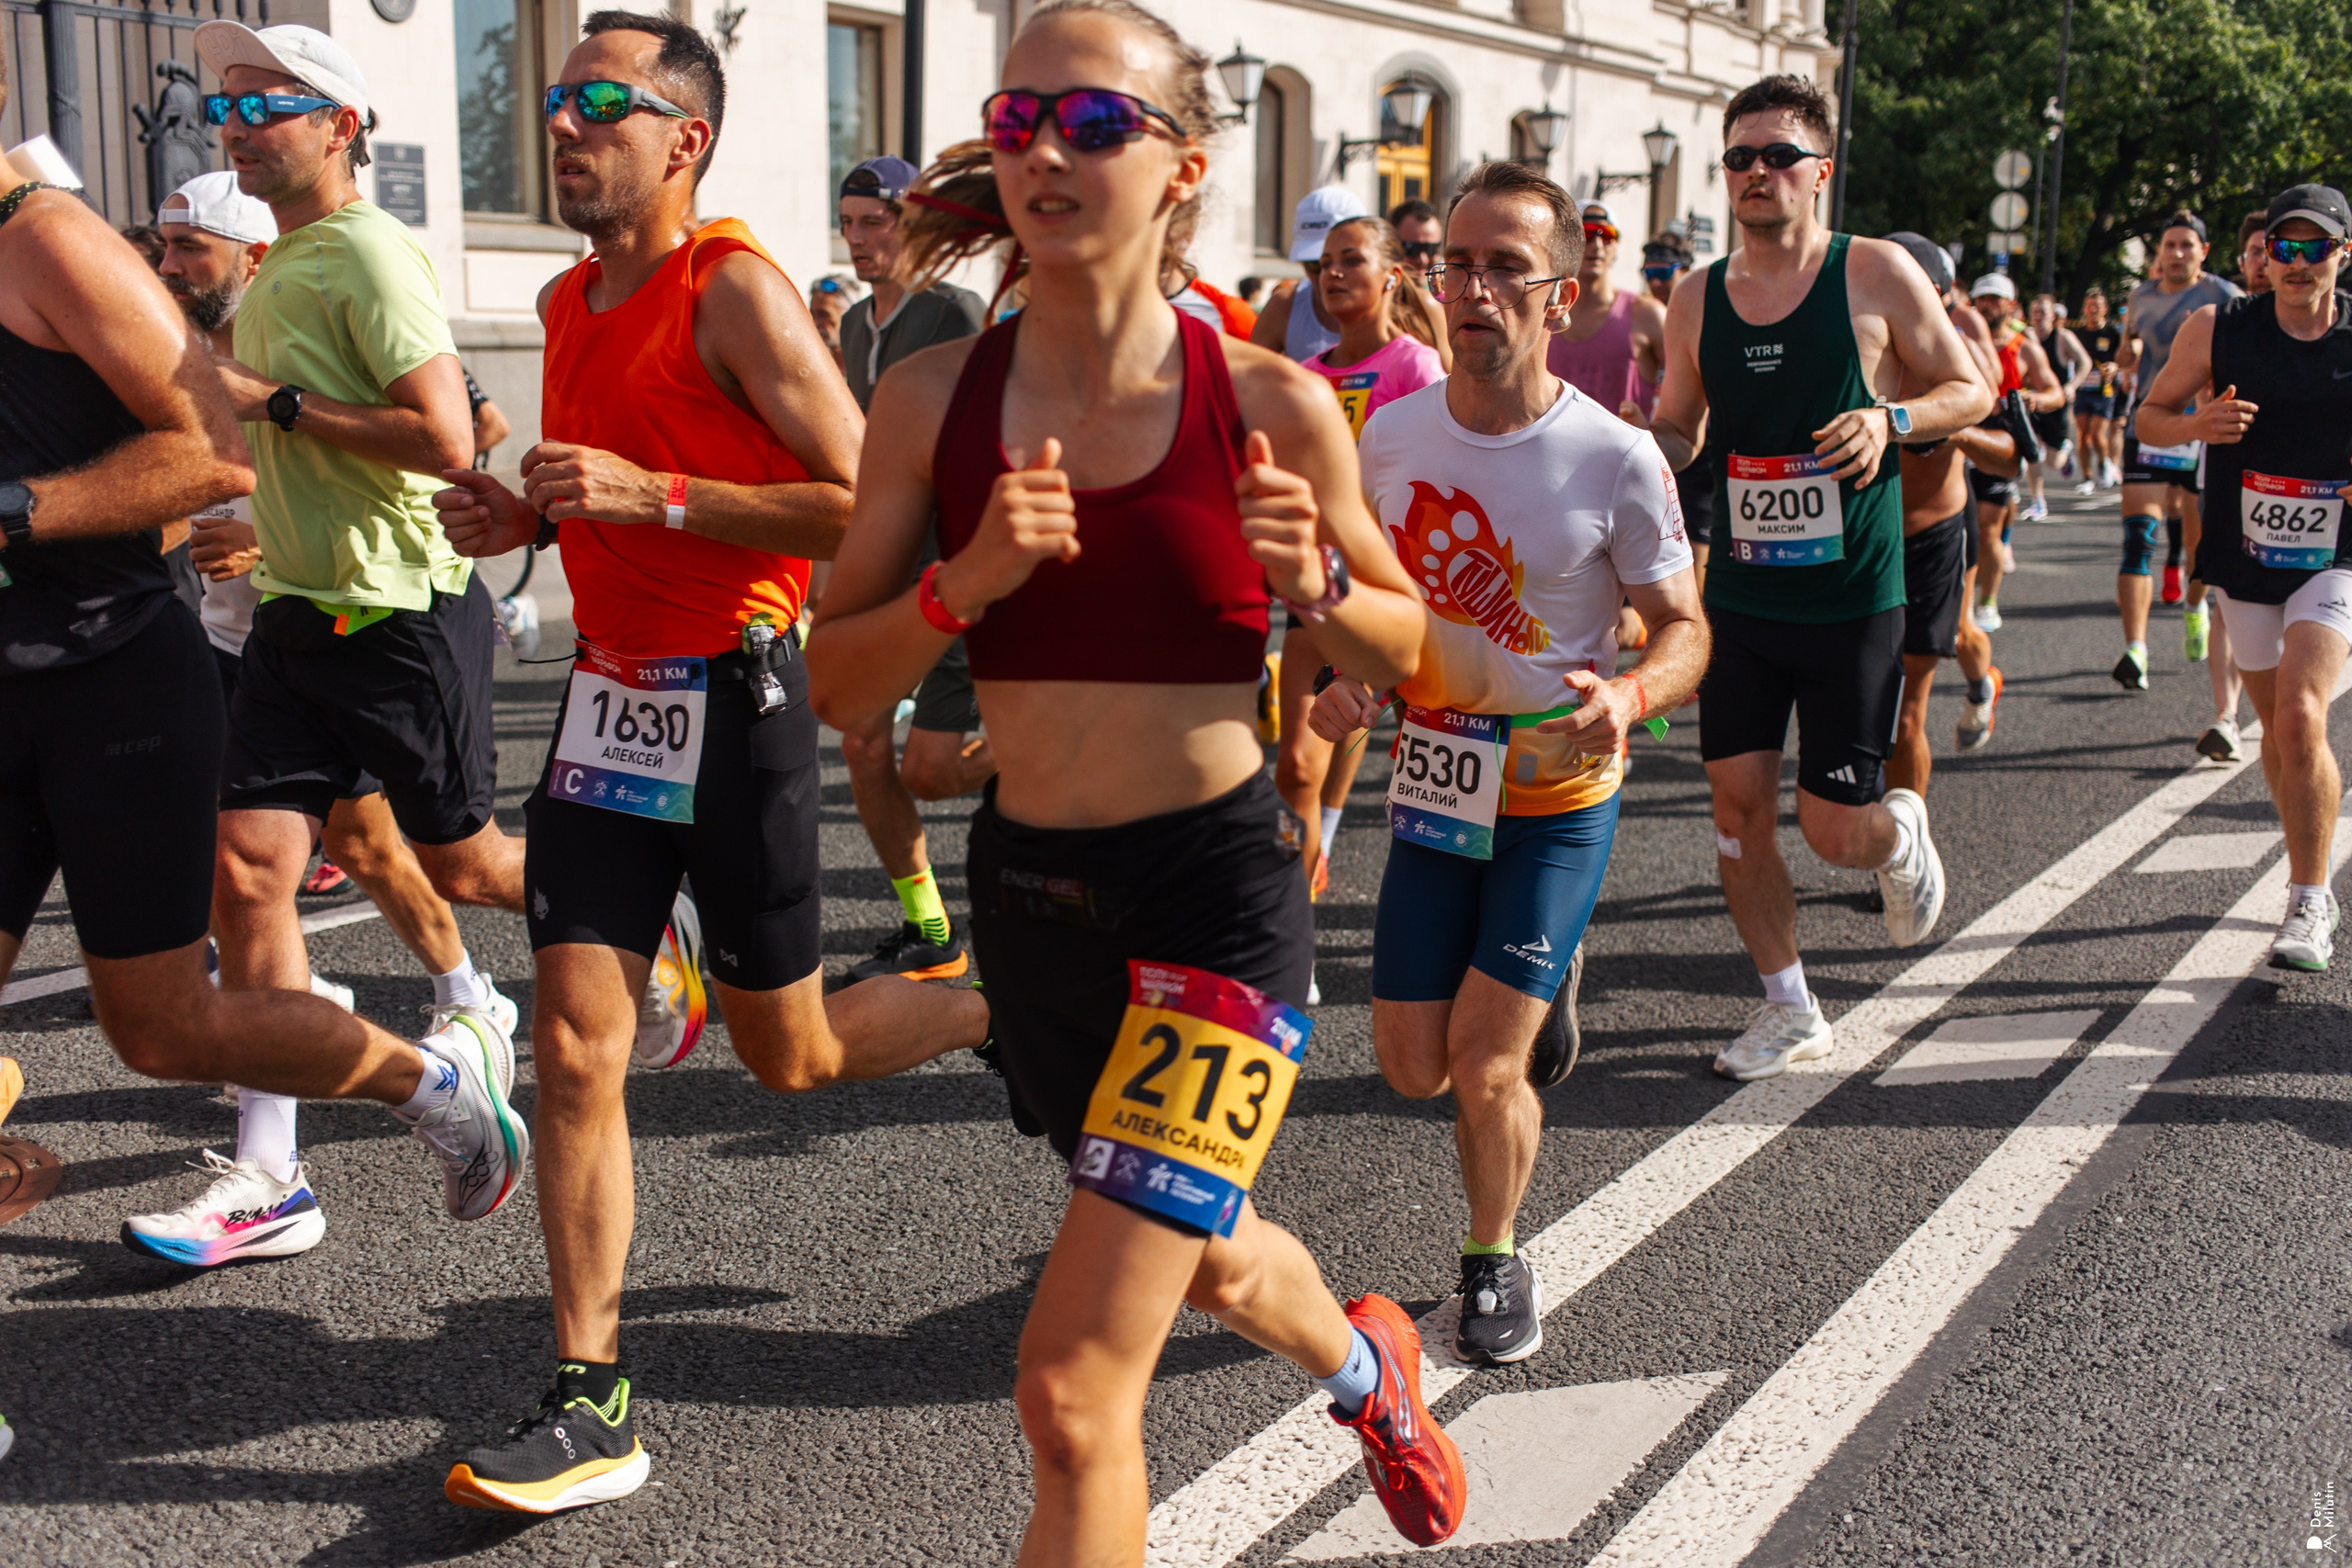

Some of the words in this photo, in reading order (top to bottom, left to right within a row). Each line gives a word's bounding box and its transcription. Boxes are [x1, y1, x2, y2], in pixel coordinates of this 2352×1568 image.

[1745, 345, 1771, 357] VTR
[1783, 462, 1802, 473] 21,1
[2300, 485, 2315, 494] 21,1
[1740, 486, 1824, 522] 6200
[2250, 501, 2328, 533] 4862
[1758, 524, 1805, 534] МАКСИМ
[2267, 533, 2301, 543] ПАВЕЛ
[1740, 542, 1752, 560] B
[637, 668, 661, 682] 21,1
[593, 690, 689, 751] 1630
[1444, 713, 1464, 728] 21,1
[601, 745, 663, 769] АЛЕКСЕЙ
[565, 769, 583, 794] C
[1397, 783, 1457, 808] ВИТАЛИЙ
[1121, 1023, 1271, 1140] 213
